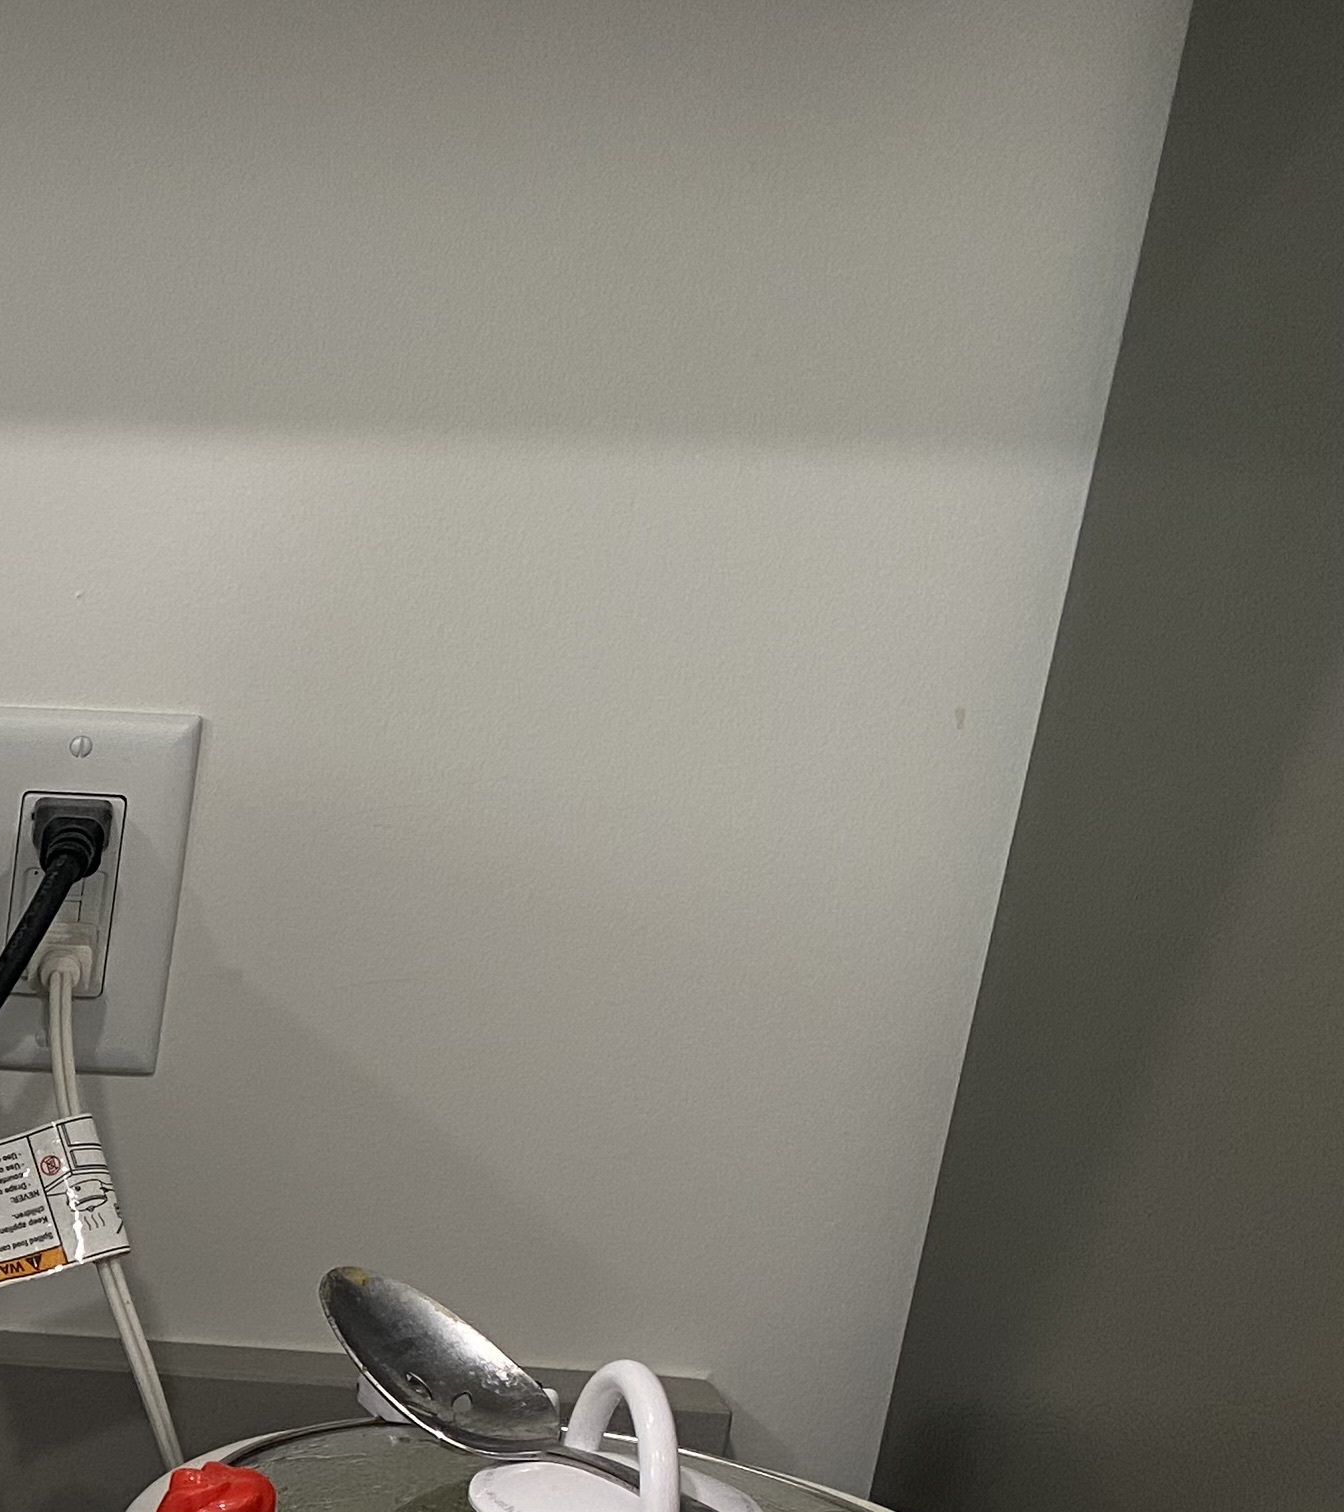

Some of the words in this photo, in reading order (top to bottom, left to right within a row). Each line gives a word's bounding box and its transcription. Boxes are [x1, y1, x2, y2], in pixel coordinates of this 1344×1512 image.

[2, 1152, 18, 1161] Use
[6, 1162, 20, 1172] Use
[4, 1183, 27, 1195] Drape
[10, 1189, 40, 1203] NEVER:
[12, 1205, 45, 1219] children.
[29, 1215, 48, 1227] Keep
[12, 1239, 29, 1251] food
[29, 1232, 53, 1246] Spilled
